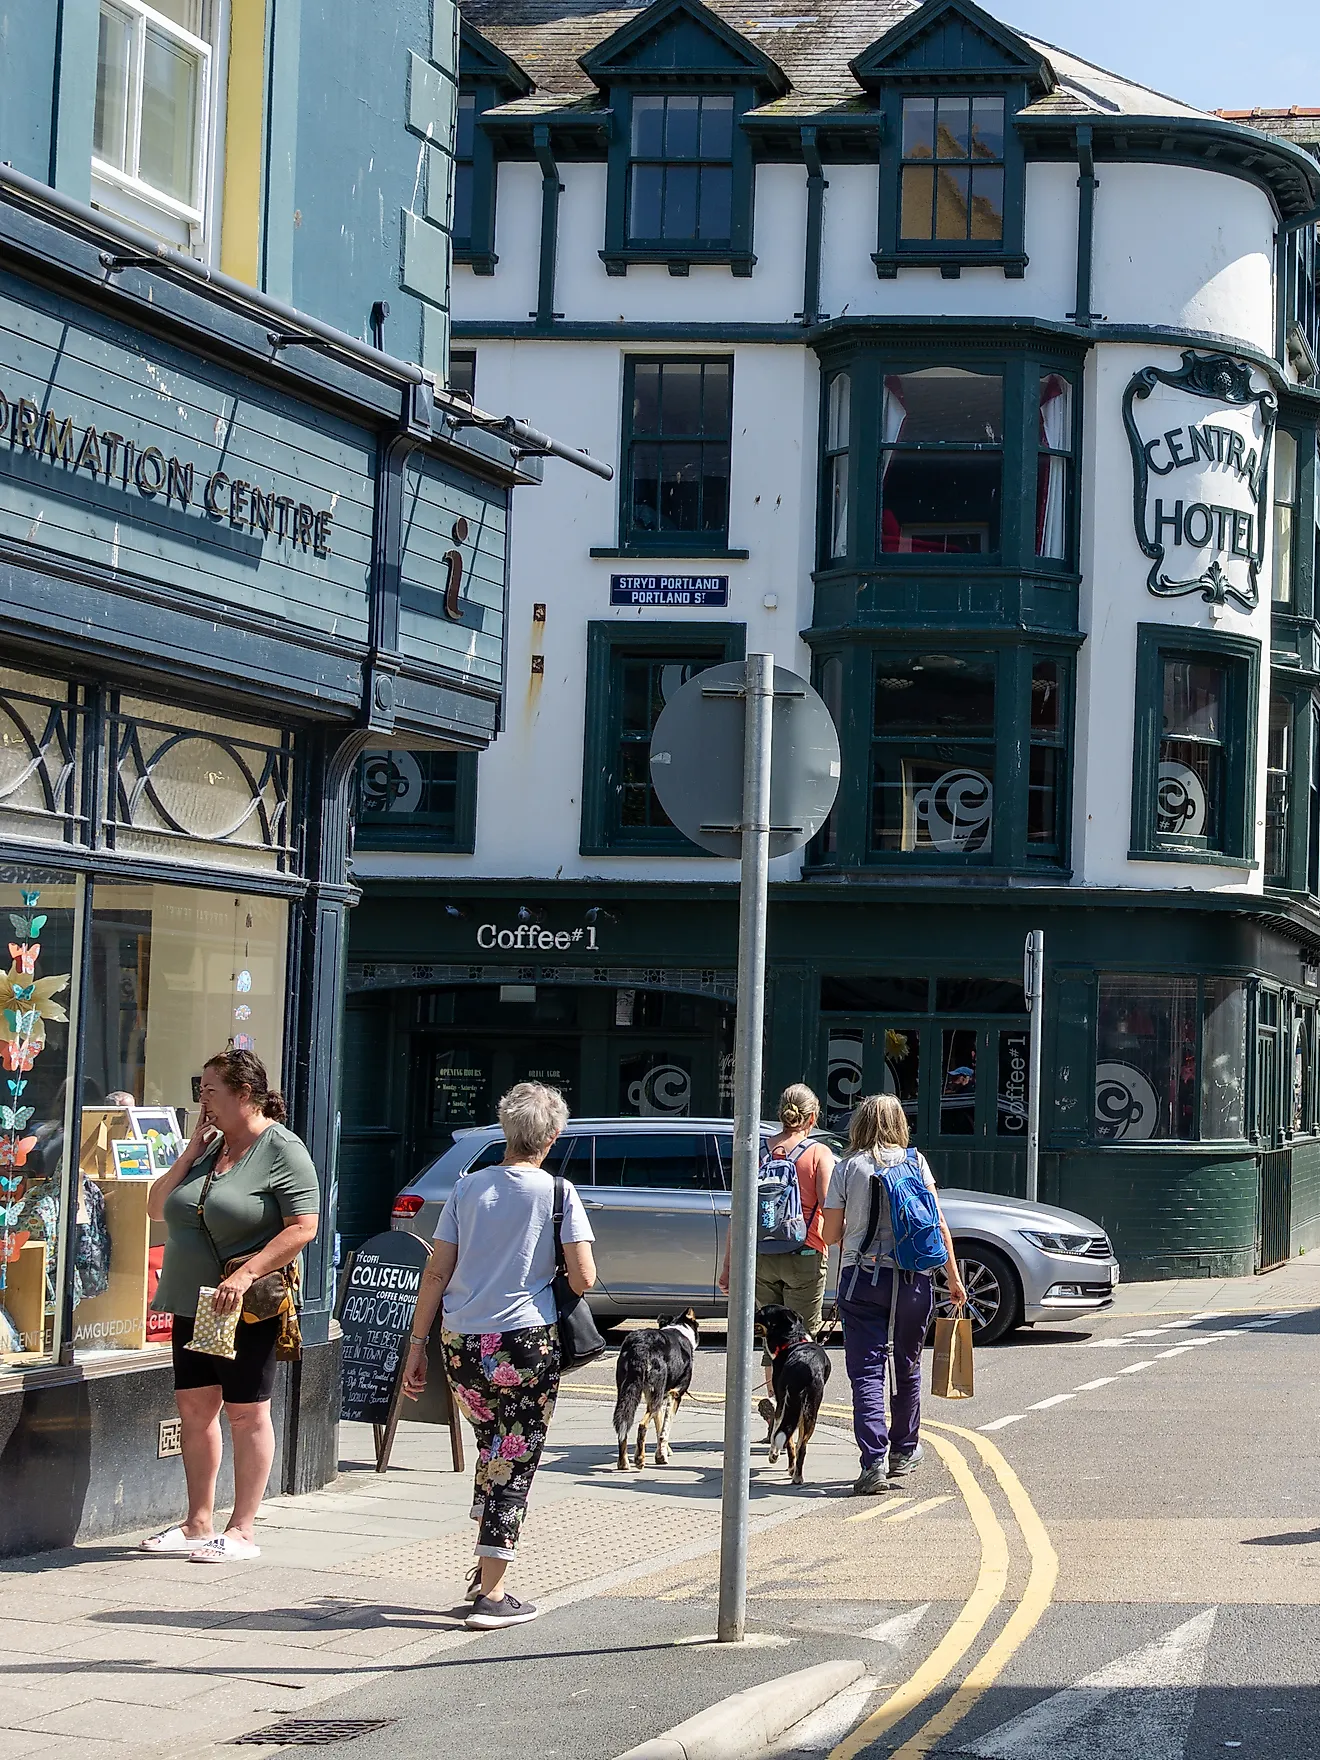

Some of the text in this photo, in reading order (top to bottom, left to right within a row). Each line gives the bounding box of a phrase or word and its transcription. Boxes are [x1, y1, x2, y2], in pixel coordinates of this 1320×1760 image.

[1144, 424, 1261, 503] CENTRAL
[207, 471, 334, 555] CENTRE
[1155, 498, 1258, 559] HOTEL
[620, 577, 719, 590] STRYD PORTLAND
[631, 592, 690, 603] PORTLAND
[363, 1254, 380, 1264] COFFI
[351, 1265, 420, 1291] COLISEUM
[376, 1291, 418, 1304] COFFEE HOUSE
[342, 1296, 376, 1324] AGOR
[74, 1313, 173, 1341] AMGUEDDFA CER
[367, 1330, 382, 1344] THE
[380, 1330, 403, 1349] BEST
[362, 1347, 386, 1360] TOWN
